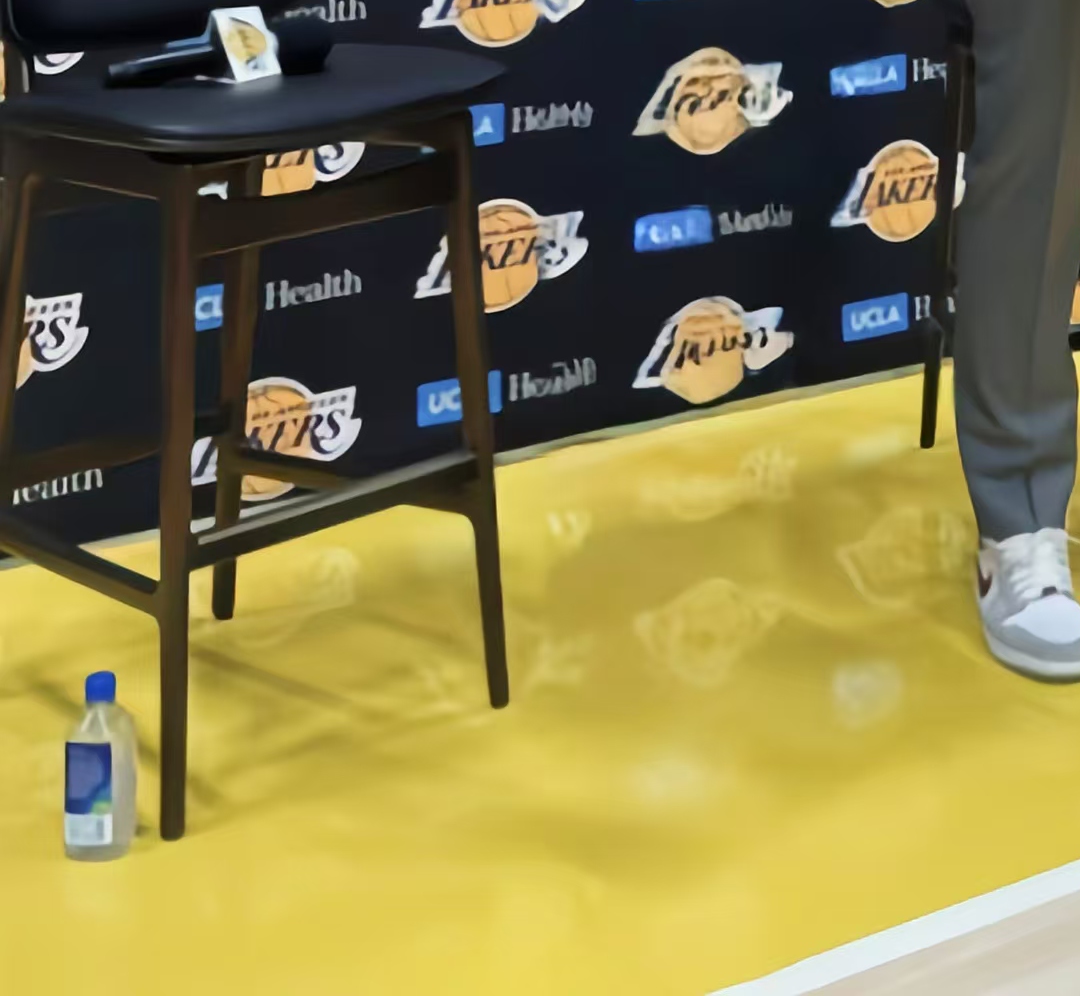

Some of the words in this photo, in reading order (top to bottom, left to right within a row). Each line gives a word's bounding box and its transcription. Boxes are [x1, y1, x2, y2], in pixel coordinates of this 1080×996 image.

[265, 268, 362, 311] Health
[850, 307, 901, 332] UCLA
[428, 387, 462, 415] UC
